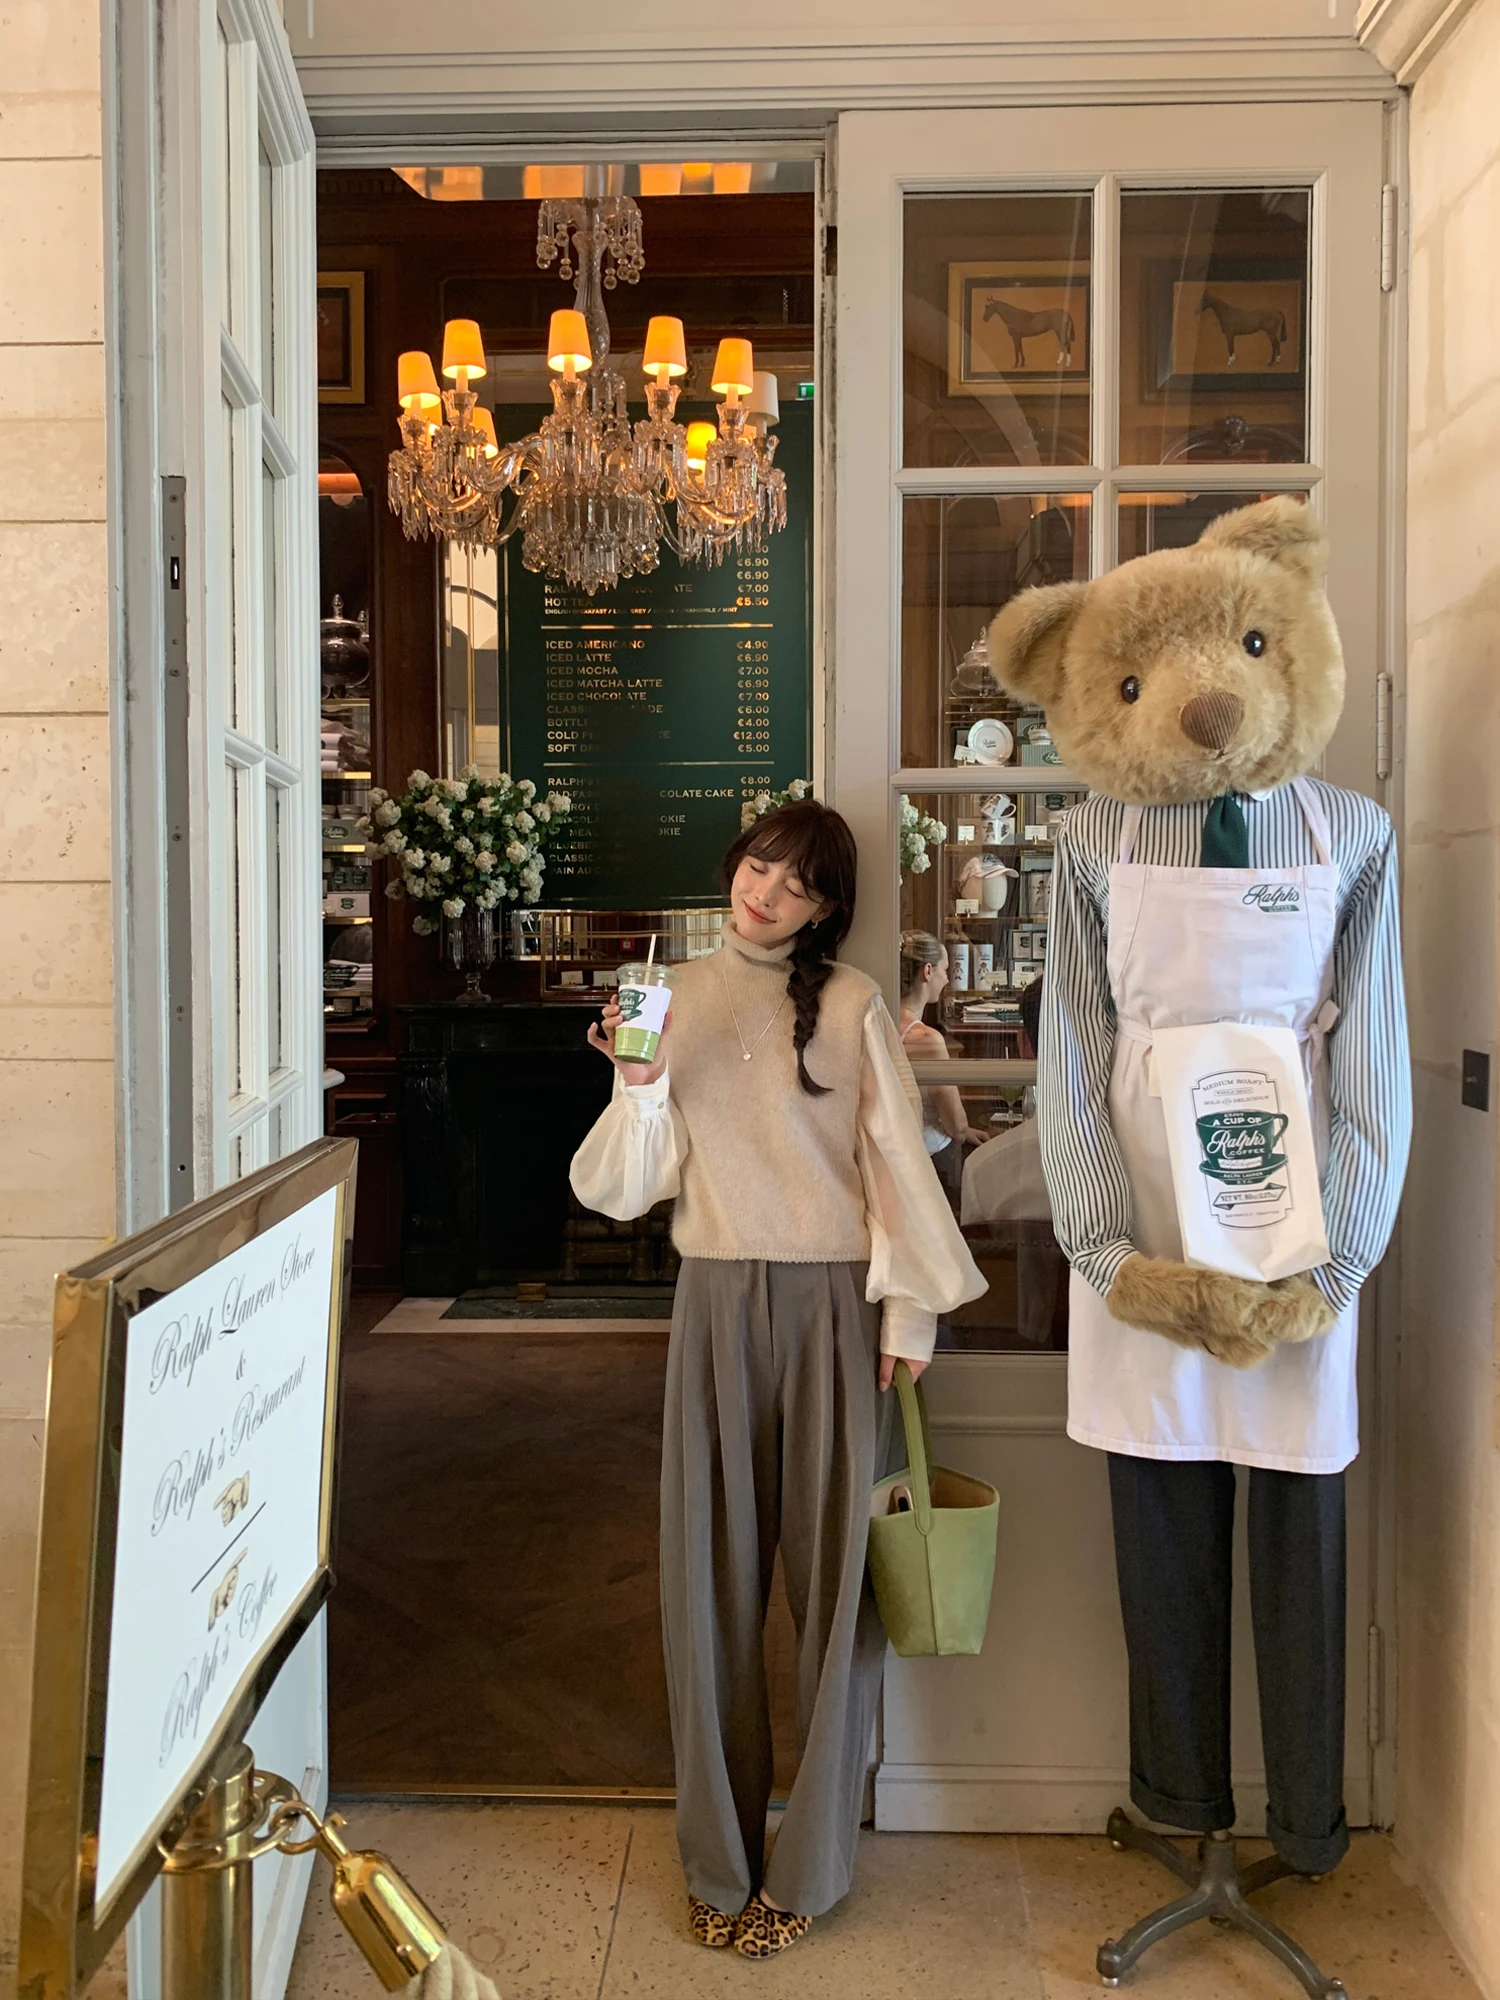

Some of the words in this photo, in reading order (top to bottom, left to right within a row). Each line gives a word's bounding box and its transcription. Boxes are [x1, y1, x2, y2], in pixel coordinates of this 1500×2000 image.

[737, 558, 769, 566] €6.90
[737, 571, 769, 580] €6.90
[738, 584, 769, 593] €7.00
[545, 598, 569, 607] HOT
[736, 597, 769, 606] €5.50
[546, 641, 573, 649] ICED
[577, 640, 645, 648] AMERICANO
[736, 641, 768, 649] €4.90
[546, 654, 573, 662] ICED
[737, 654, 768, 662] €6.90
[546, 667, 573, 675] ICED
[577, 667, 619, 675] MOCHA
[738, 667, 768, 675] €7.00
[628, 679, 663, 687] LATTE
[737, 680, 769, 688] €6.90
[738, 692, 769, 700] €7.00
[737, 706, 769, 714] €6.00
[738, 719, 769, 727] €4.00
[547, 731, 579, 740] COLD
[733, 732, 769, 740] €12.00
[547, 744, 577, 752] SOFT
[738, 744, 769, 752] €5.00
[740, 776, 771, 784] €8.00
[660, 790, 702, 798] COLATE
[705, 789, 734, 797] CAKE
[577, 866, 592, 875] AU
[1242, 884, 1299, 907] Ralph's
[1203, 1080, 1233, 1091] MEDIUM
[1207, 1130, 1265, 1159] Ralph's
[150, 1307, 213, 1395] Ralph
[218, 1273, 275, 1340] Lauren
[281, 1232, 315, 1301] Store
[236, 1349, 246, 1380] &
[151, 1428, 226, 1537] Ralph's
[230, 1356, 305, 1457] Restaurant
[159, 1624, 230, 1768] Ralph's
[238, 1562, 277, 1642] Coffee
